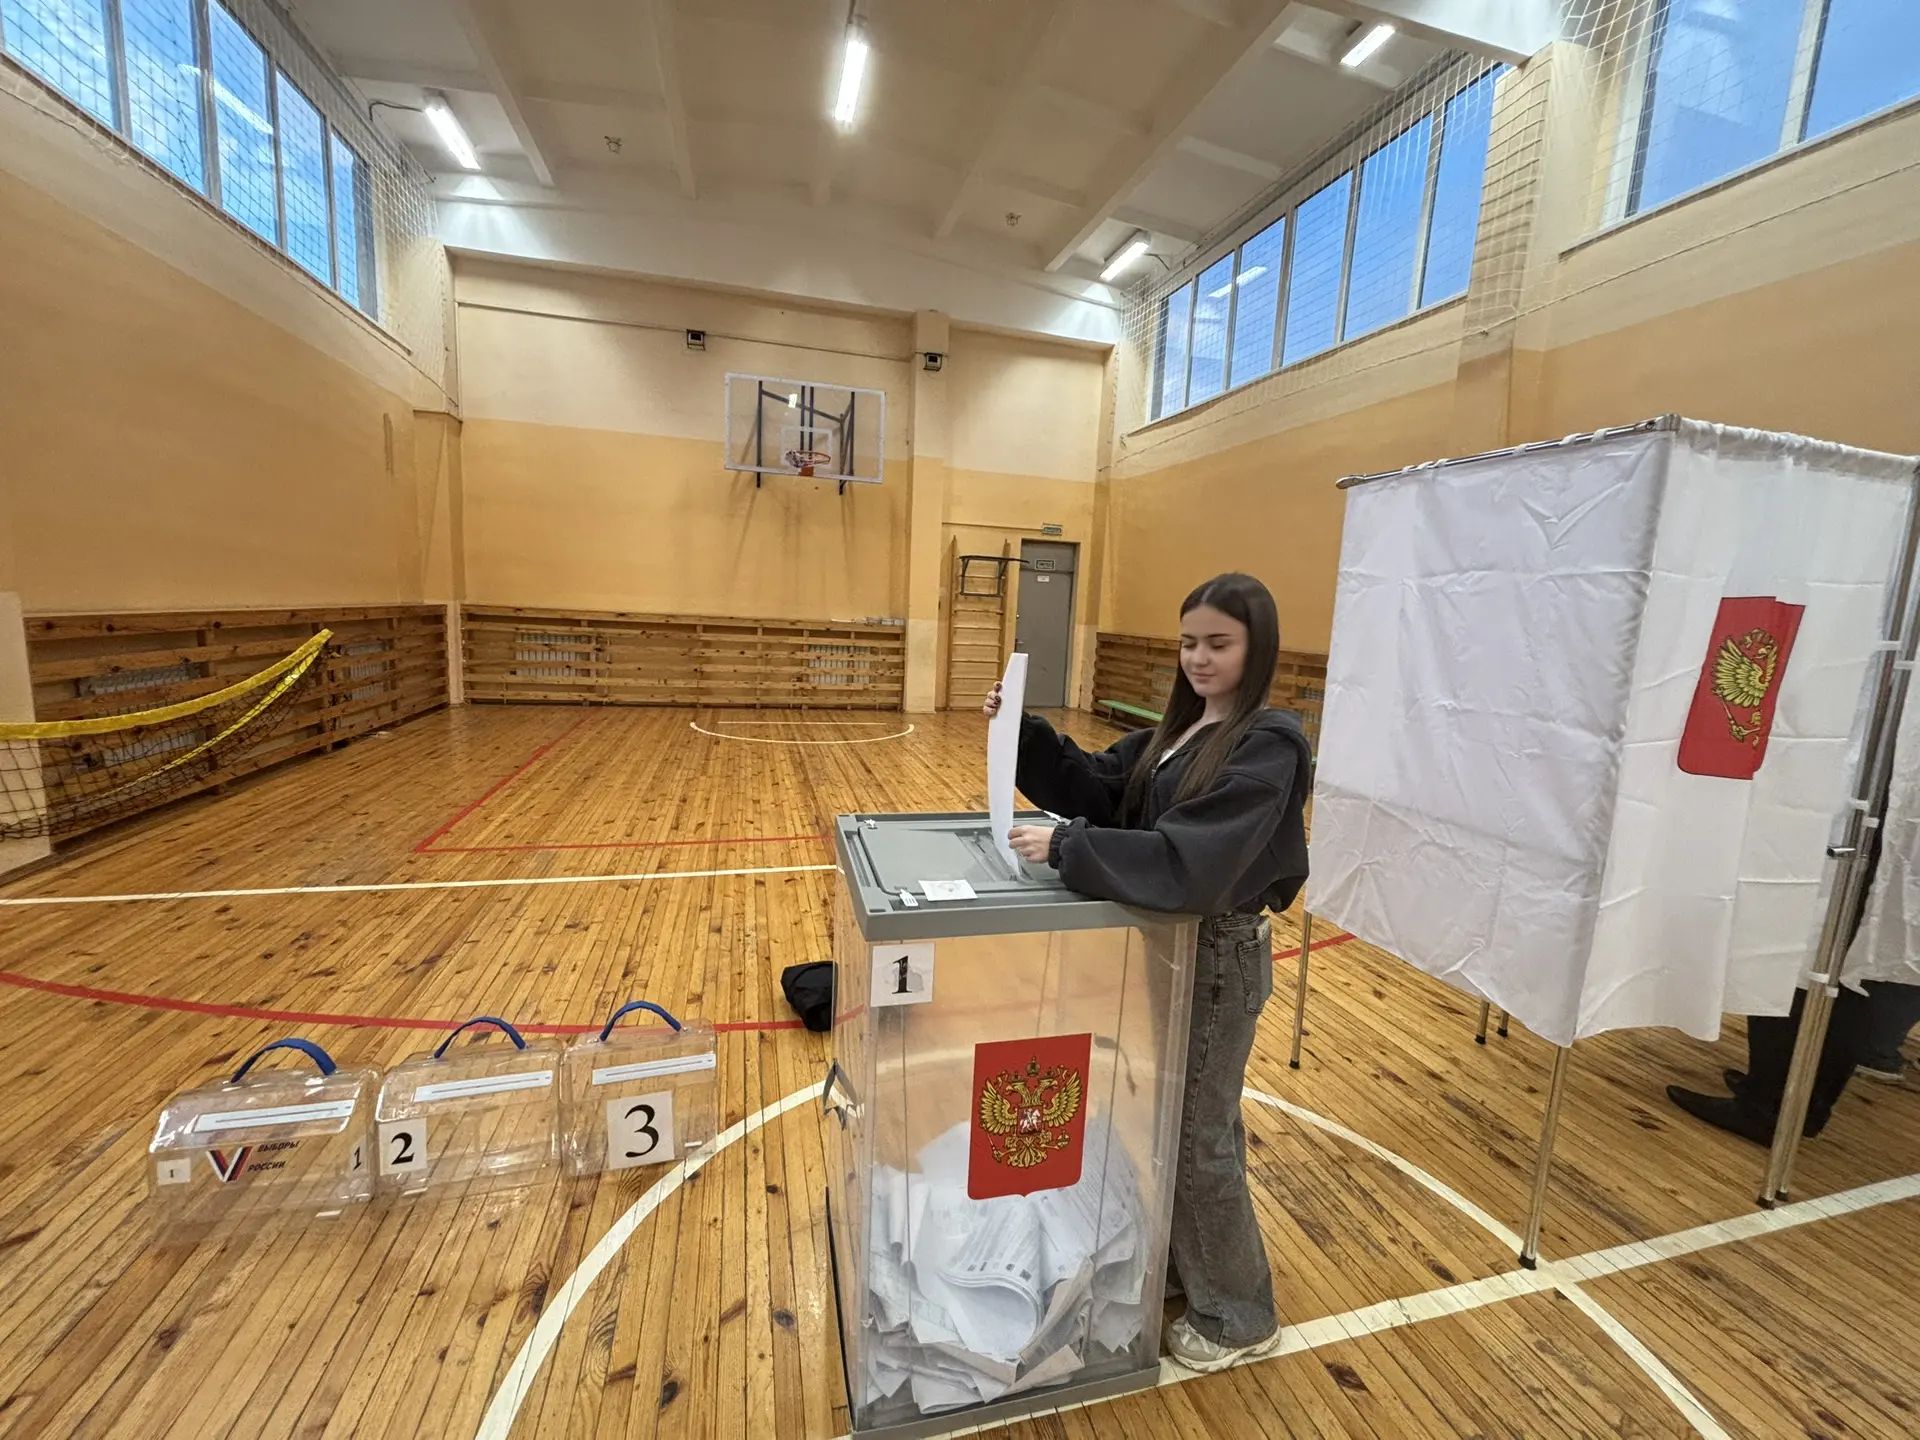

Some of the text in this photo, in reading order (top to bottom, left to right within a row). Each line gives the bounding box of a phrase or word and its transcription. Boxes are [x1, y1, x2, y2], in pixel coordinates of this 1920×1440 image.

[892, 955, 912, 994] 1
[257, 1140, 300, 1152] ВЫБОРЫ
[623, 1104, 660, 1159] 3
[353, 1146, 362, 1171] 1
[390, 1131, 415, 1165] 2
[248, 1161, 286, 1172] РОССИИ
